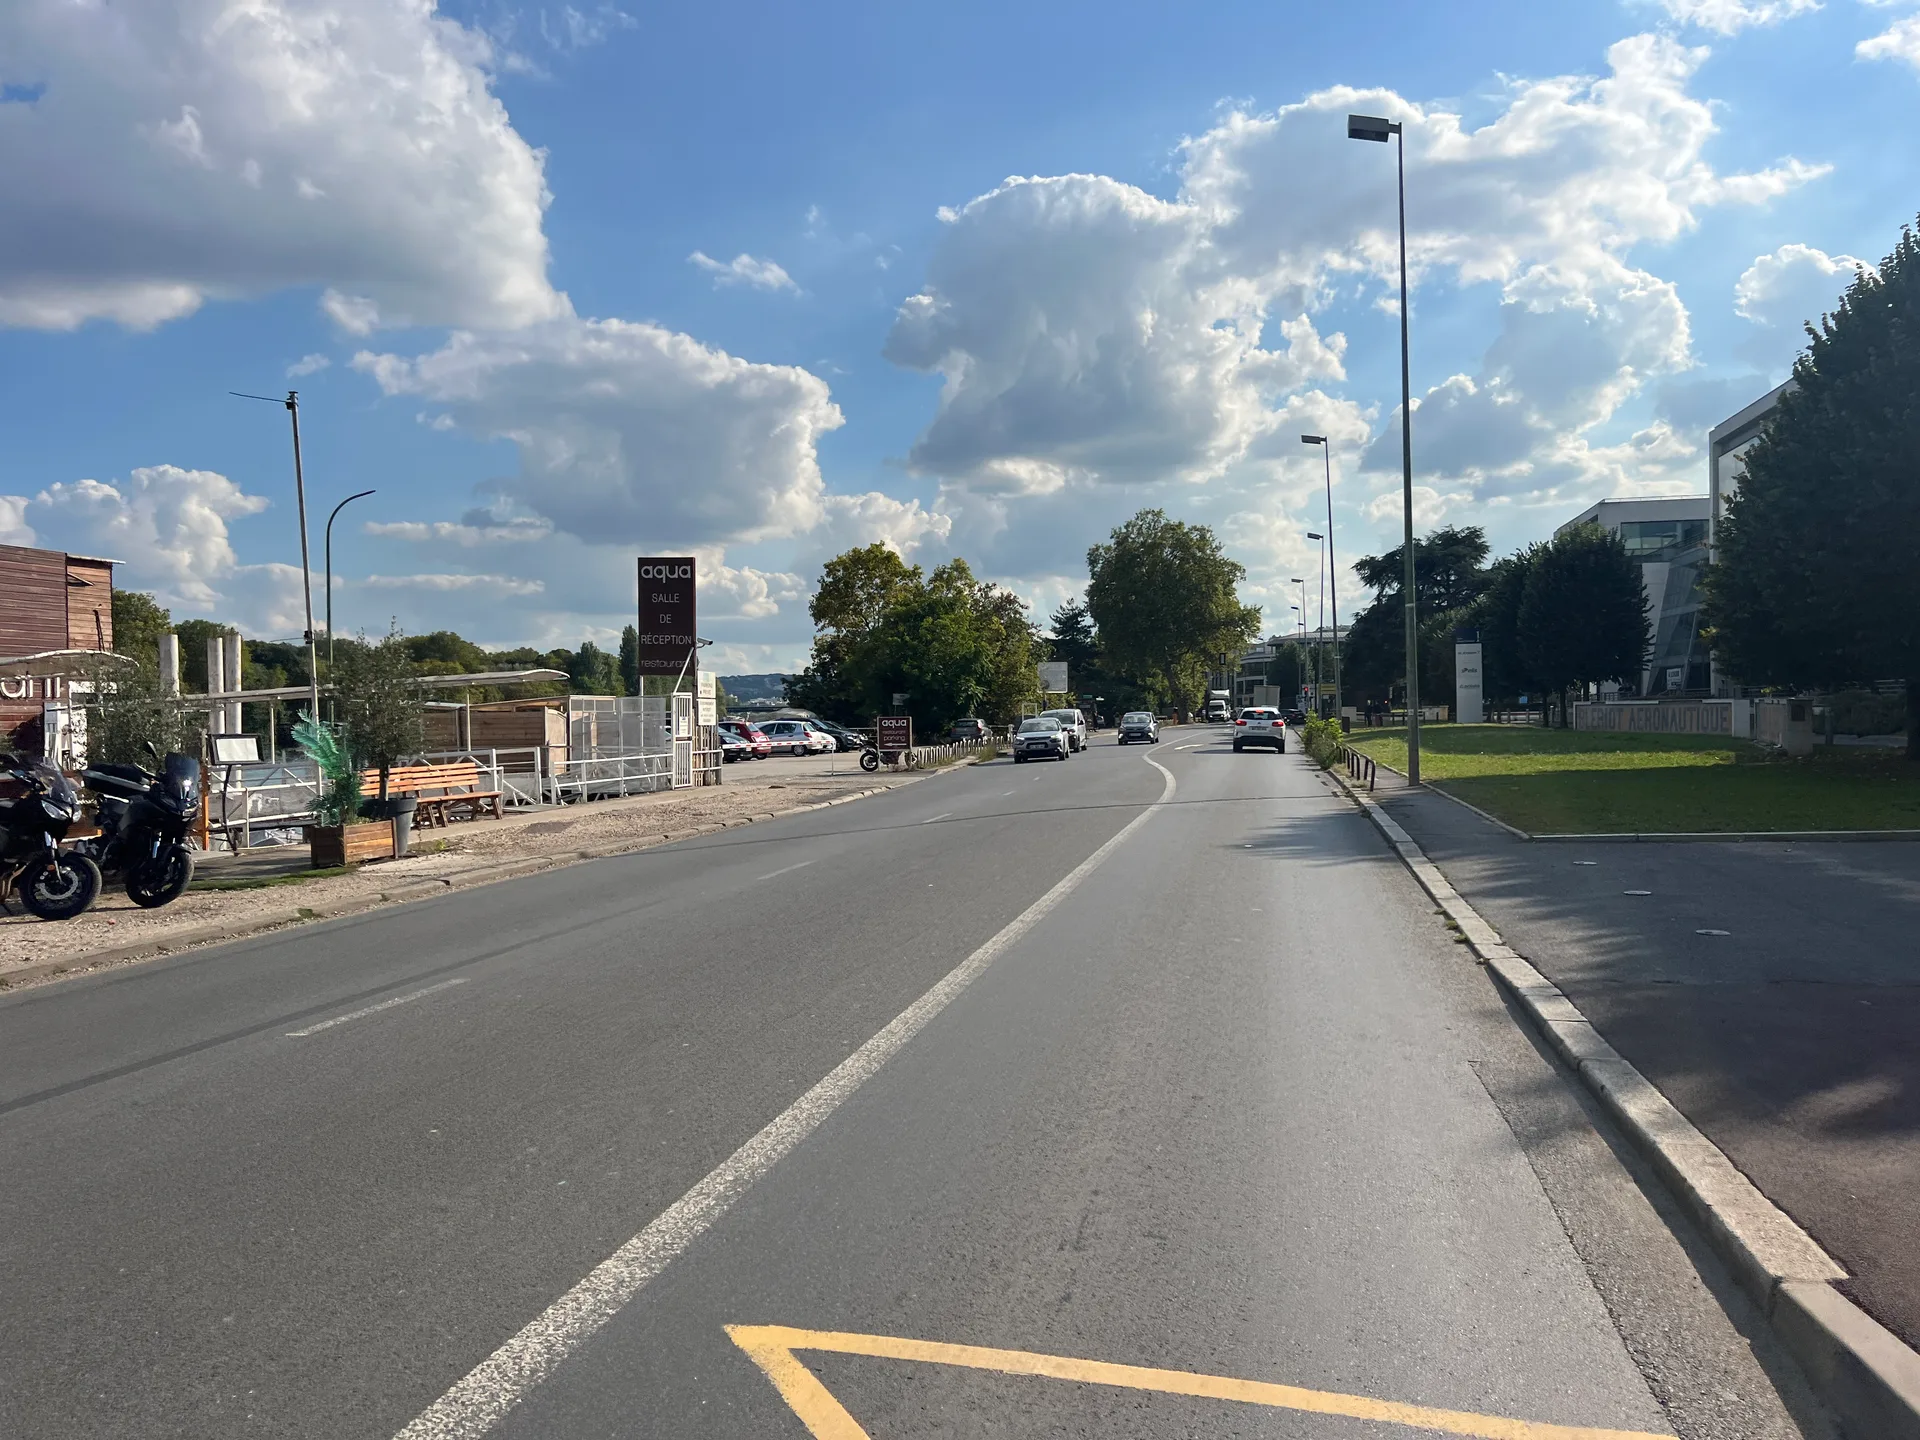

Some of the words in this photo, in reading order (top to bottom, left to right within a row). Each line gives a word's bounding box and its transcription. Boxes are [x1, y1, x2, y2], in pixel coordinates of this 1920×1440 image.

[641, 565, 691, 583] aqua
[652, 593, 680, 603] SALLE
[659, 614, 672, 624] DE
[641, 632, 692, 644] RÉCEPTION
[882, 719, 906, 728] aqua
[1629, 705, 1729, 731] AERONAUTIQUE
